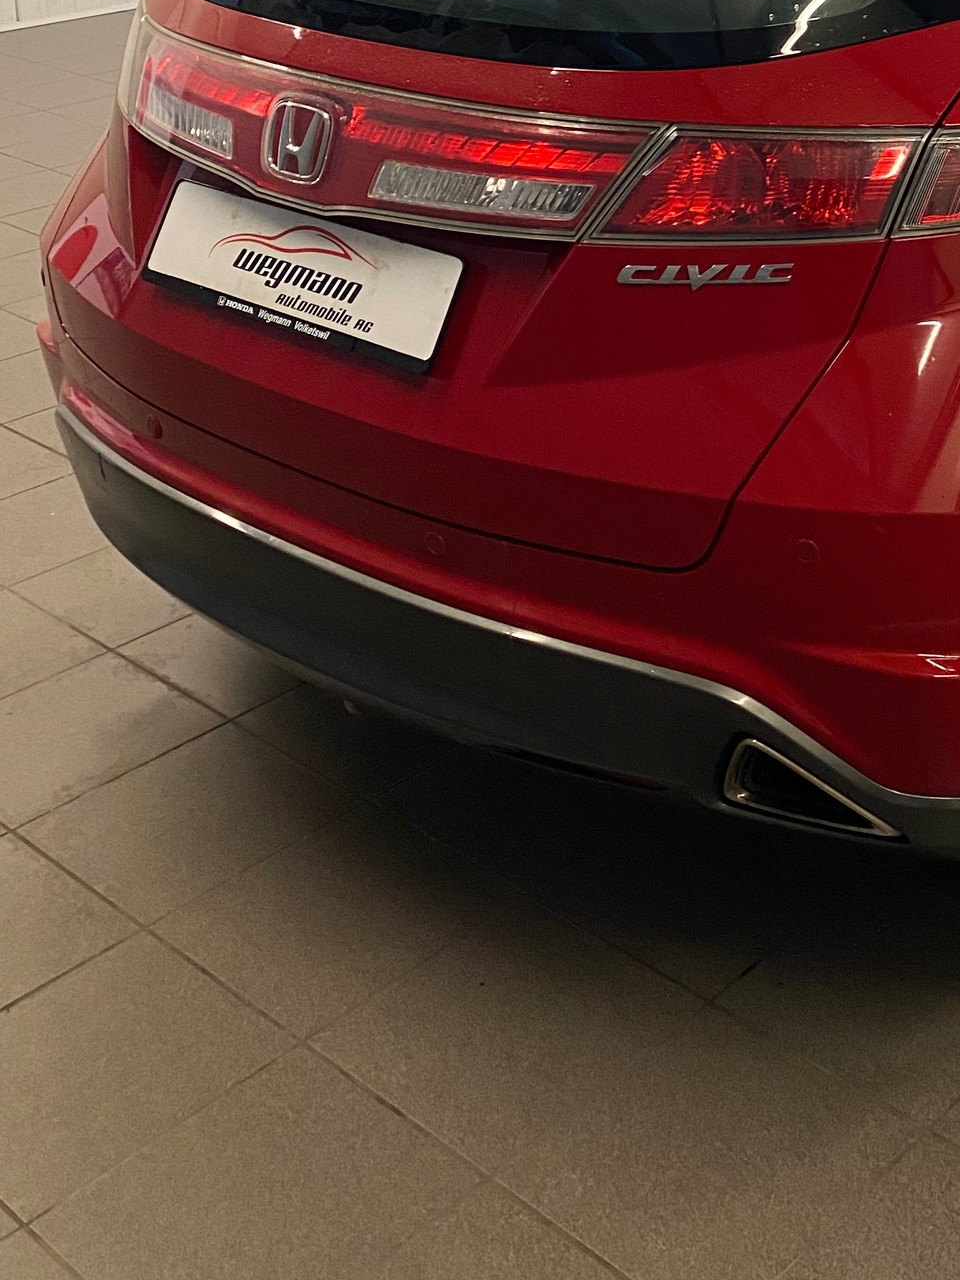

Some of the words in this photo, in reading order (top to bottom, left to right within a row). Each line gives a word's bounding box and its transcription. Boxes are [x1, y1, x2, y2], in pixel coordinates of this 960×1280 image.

[232, 248, 363, 304] wegmann
[616, 263, 795, 291] CIVIC
[224, 299, 254, 315] HONDA
[257, 308, 292, 328] Wegmann
[294, 320, 331, 341] Volketswil
[353, 318, 375, 333] AG
